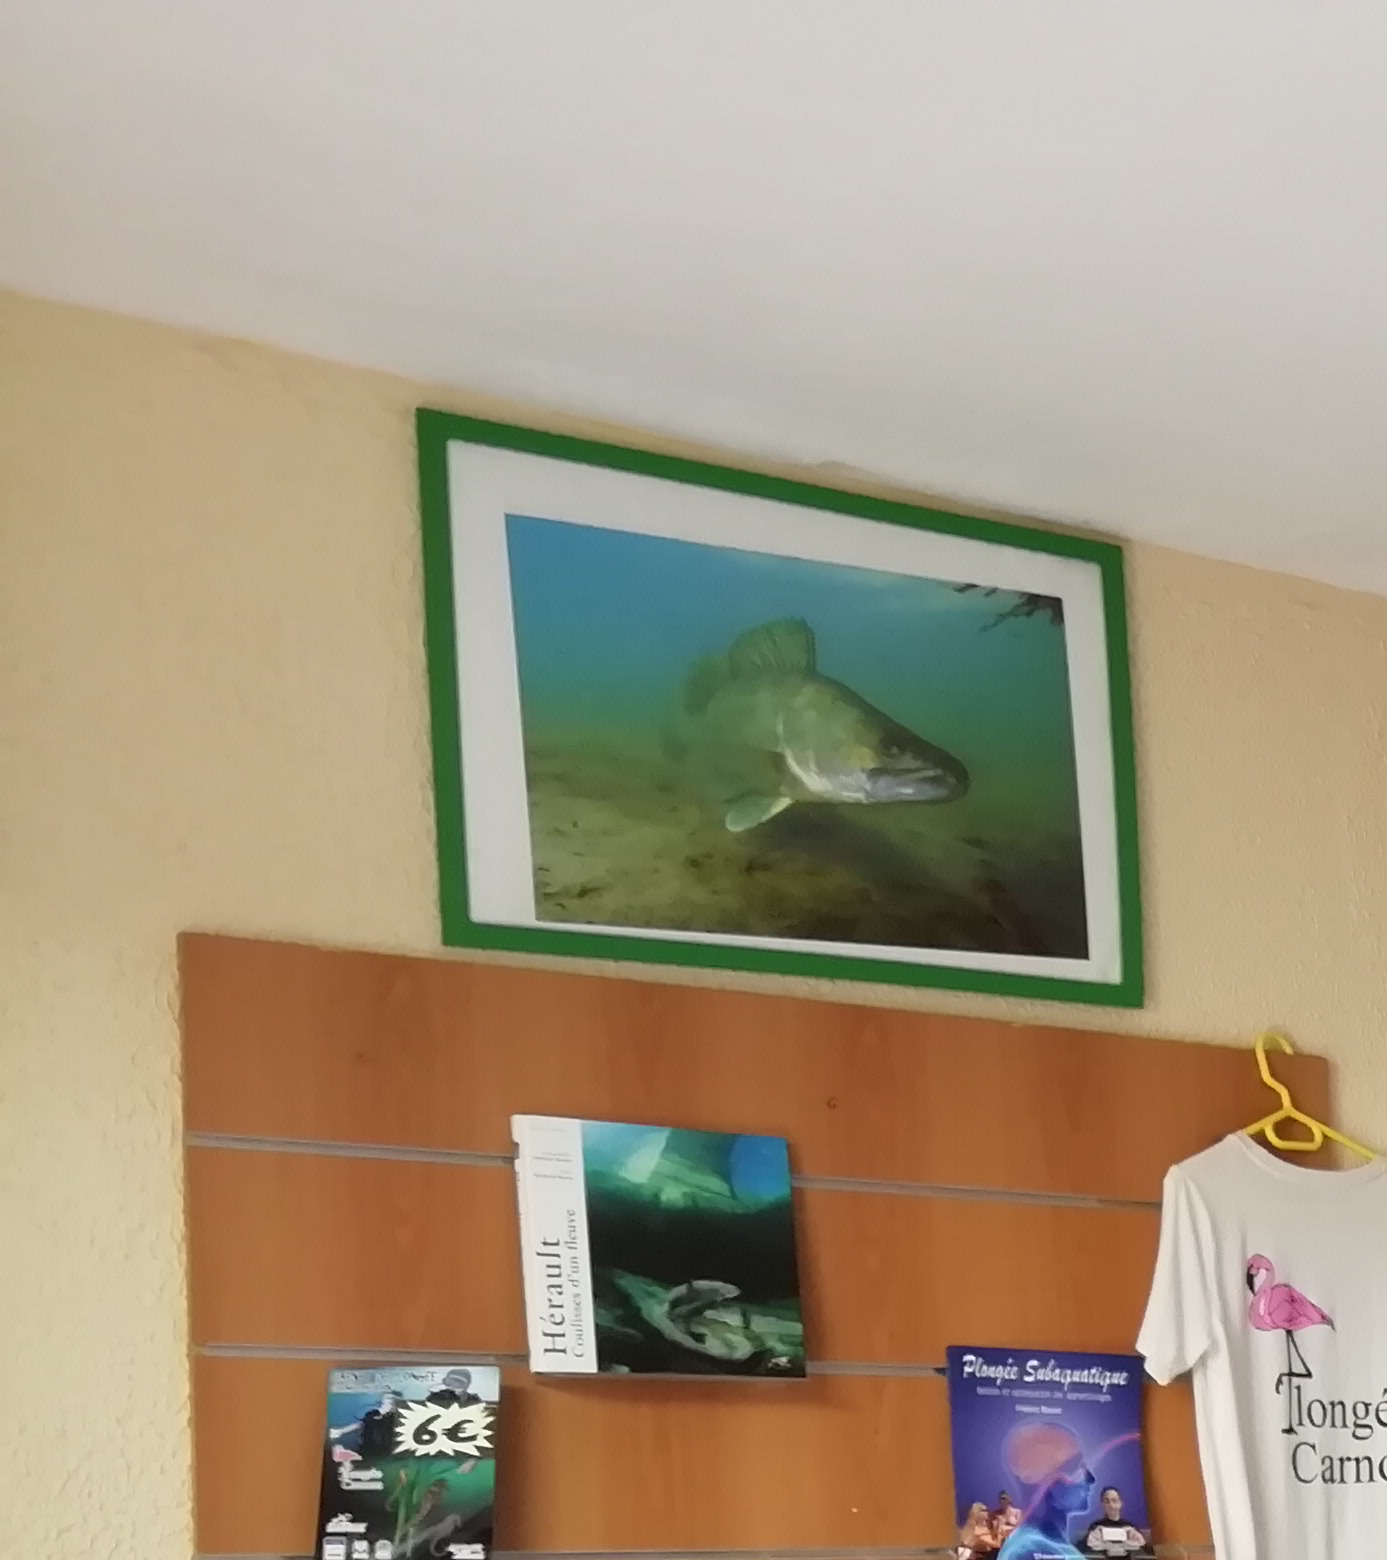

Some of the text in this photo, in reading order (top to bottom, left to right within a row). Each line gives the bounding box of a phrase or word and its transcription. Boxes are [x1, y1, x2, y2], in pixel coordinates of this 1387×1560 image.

[535, 1236, 568, 1357] Hérault
[1022, 1358, 1130, 1393] Subaquatique
[412, 1413, 479, 1446] 6€
